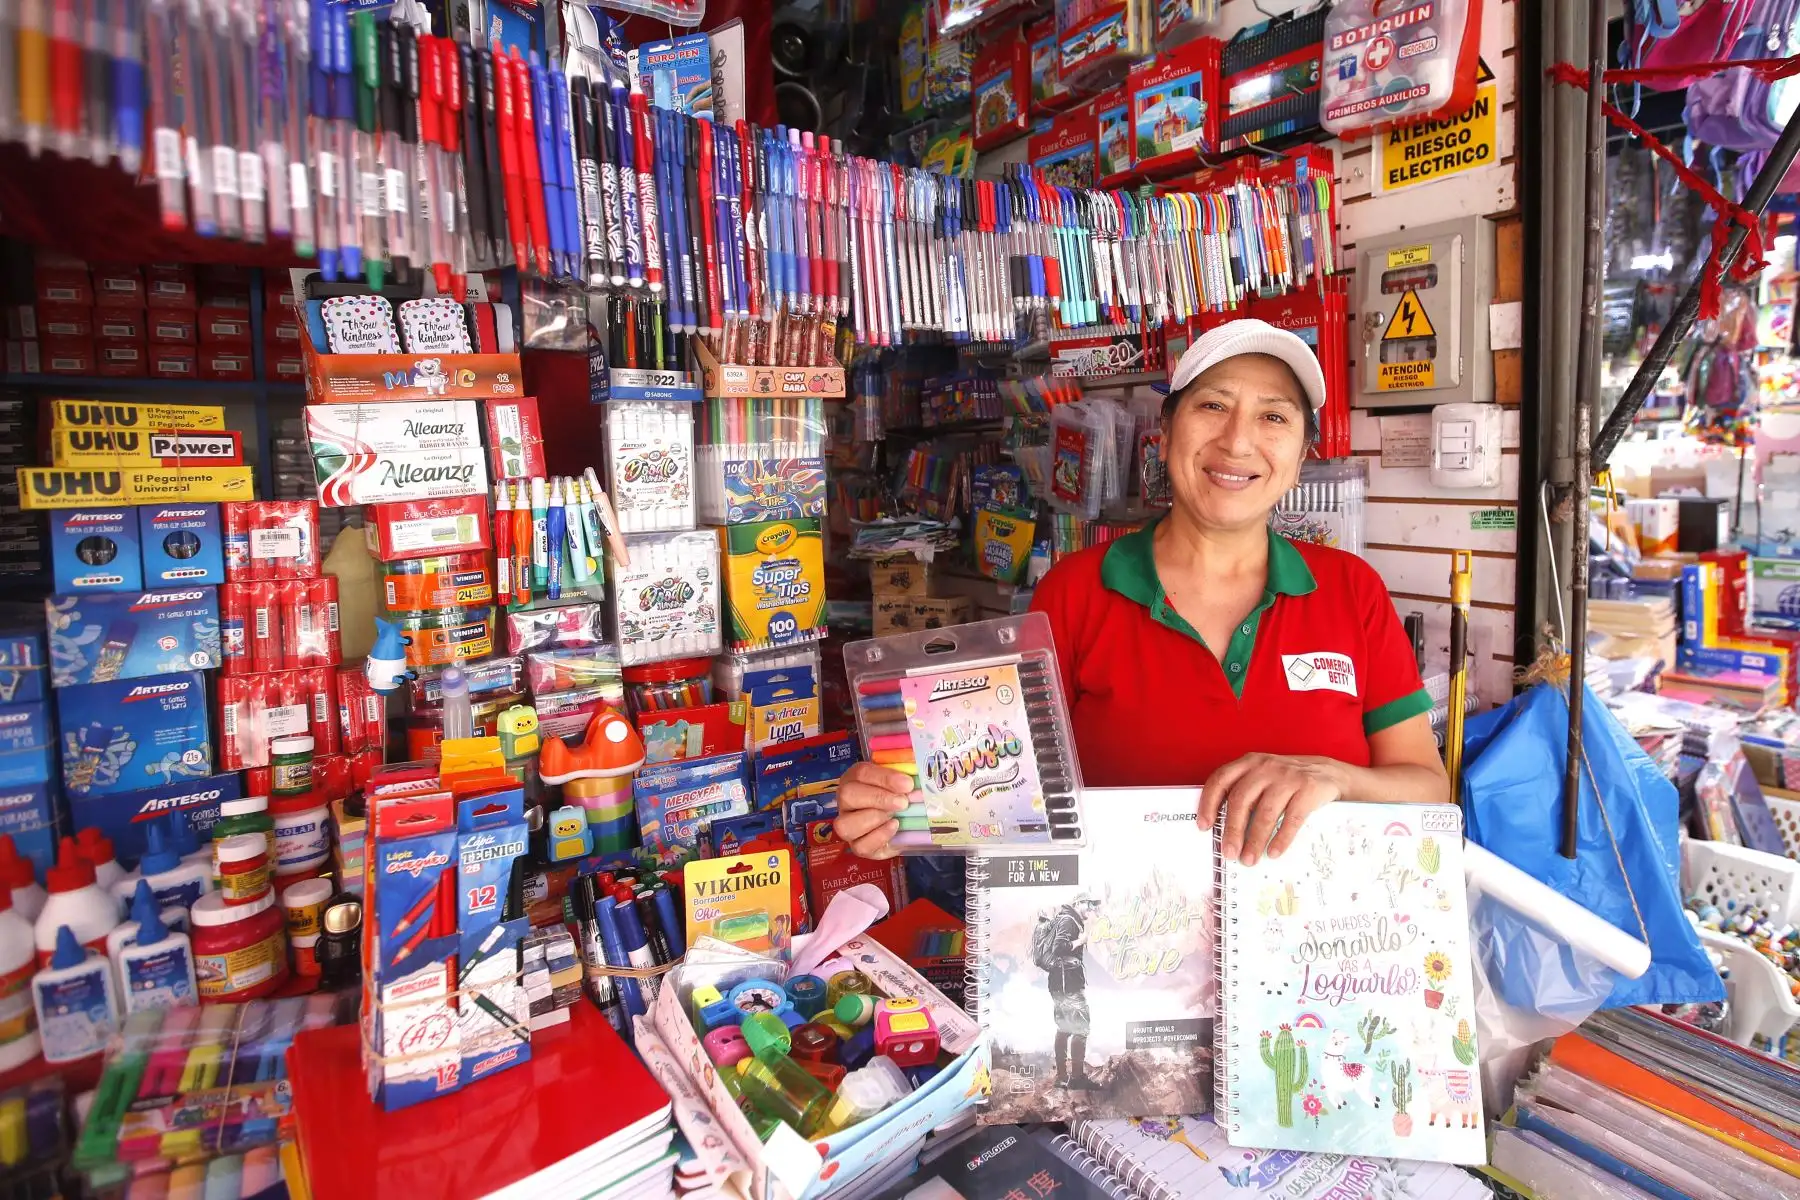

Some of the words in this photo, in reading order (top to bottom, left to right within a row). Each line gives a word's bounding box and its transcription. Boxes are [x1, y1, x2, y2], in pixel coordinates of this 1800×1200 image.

[1332, 5, 1431, 48] BOTIQUIN
[648, 53, 676, 64] EURO
[679, 48, 699, 58] PEN
[1143, 66, 1192, 87] FABER-CASTELL
[1328, 101, 1377, 120] PRIMEROS
[1378, 86, 1427, 105] AUXILIOS
[1040, 132, 1088, 156] FABER-CASTELL
[1404, 128, 1472, 161] RIESGO
[1389, 143, 1490, 185] ELECTRICO
[1403, 252, 1414, 260] TG
[341, 327, 383, 342] kindness
[418, 329, 455, 343] kindness
[1108, 342, 1130, 366] 20
[783, 372, 805, 382] CAPY
[1382, 363, 1431, 376] ATENCIÓN
[496, 373, 509, 383] 12
[646, 374, 675, 386] P922
[493, 383, 515, 393] PCS
[782, 383, 808, 393] BARA
[65, 404, 139, 427] UHU
[147, 407, 155, 415] El
[403, 420, 464, 438] Alleanza
[69, 431, 140, 451] UHU
[153, 438, 233, 456] Power
[380, 459, 475, 487] Alleanza
[624, 457, 679, 483] Doodle
[727, 463, 745, 474] 100
[32, 471, 122, 496] UHU
[133, 475, 144, 483] El
[146, 474, 213, 484] Pegamento
[133, 484, 190, 493] Universal
[70, 512, 124, 522] ARTESCO
[156, 509, 207, 519] ARTESCO
[1481, 510, 1515, 518] IMPRENTA
[761, 528, 792, 544] Crayola
[456, 573, 483, 582] VINIFAN
[752, 567, 803, 585] Super
[458, 590, 472, 601] 24
[639, 581, 695, 612] Doodle
[778, 581, 811, 598] Tips
[135, 591, 205, 605] ARTESCO
[452, 626, 483, 638] VINIFAN
[769, 619, 795, 634] 100
[456, 645, 471, 657] 24
[474, 668, 506, 679] ARTESCO
[1313, 657, 1354, 676] COMERCIAL
[933, 675, 987, 691] ARTESCO
[1328, 671, 1349, 686] BETTY
[128, 682, 190, 696] ARTESCO
[999, 690, 1009, 699] 12
[776, 706, 808, 720] Arteza
[770, 720, 802, 740] Lupa
[185, 752, 199, 762] 21g
[828, 746, 836, 758] 12
[925, 724, 1023, 791] Brush
[765, 760, 793, 771] ARTESCO
[139, 789, 221, 812] ARTESCO
[665, 784, 724, 809] MERCYFAN
[1143, 811, 1198, 823] EXPLORER
[461, 835, 496, 850] Lápiz
[386, 850, 414, 862] Lápiz
[462, 842, 524, 864] TECNICO
[465, 864, 481, 874] 2B
[1008, 859, 1025, 871] IT'S
[1027, 859, 1049, 871] TIME
[694, 871, 781, 897] VIKINGO
[822, 869, 884, 890] FABER-CASTELL
[1008, 871, 1025, 883] FOR
[1029, 871, 1036, 882] A
[1039, 870, 1060, 882] NEW
[468, 885, 497, 909] 12
[693, 893, 736, 906] Borradores
[1314, 921, 1328, 933] SI
[1330, 915, 1372, 931] PUEDES
[1291, 915, 1419, 964] Soñarlo
[1338, 959, 1360, 973] VAS
[1363, 959, 1373, 973] A
[391, 975, 440, 994] MERCYFAN
[935, 982, 963, 990] EON
[1297, 963, 1418, 1007] Lograrlo
[1154, 1025, 1175, 1033] #GOALS
[473, 1050, 519, 1074] MERCYFAN
[437, 1063, 457, 1085] 12
[966, 1136, 1017, 1171] EXPLORER
